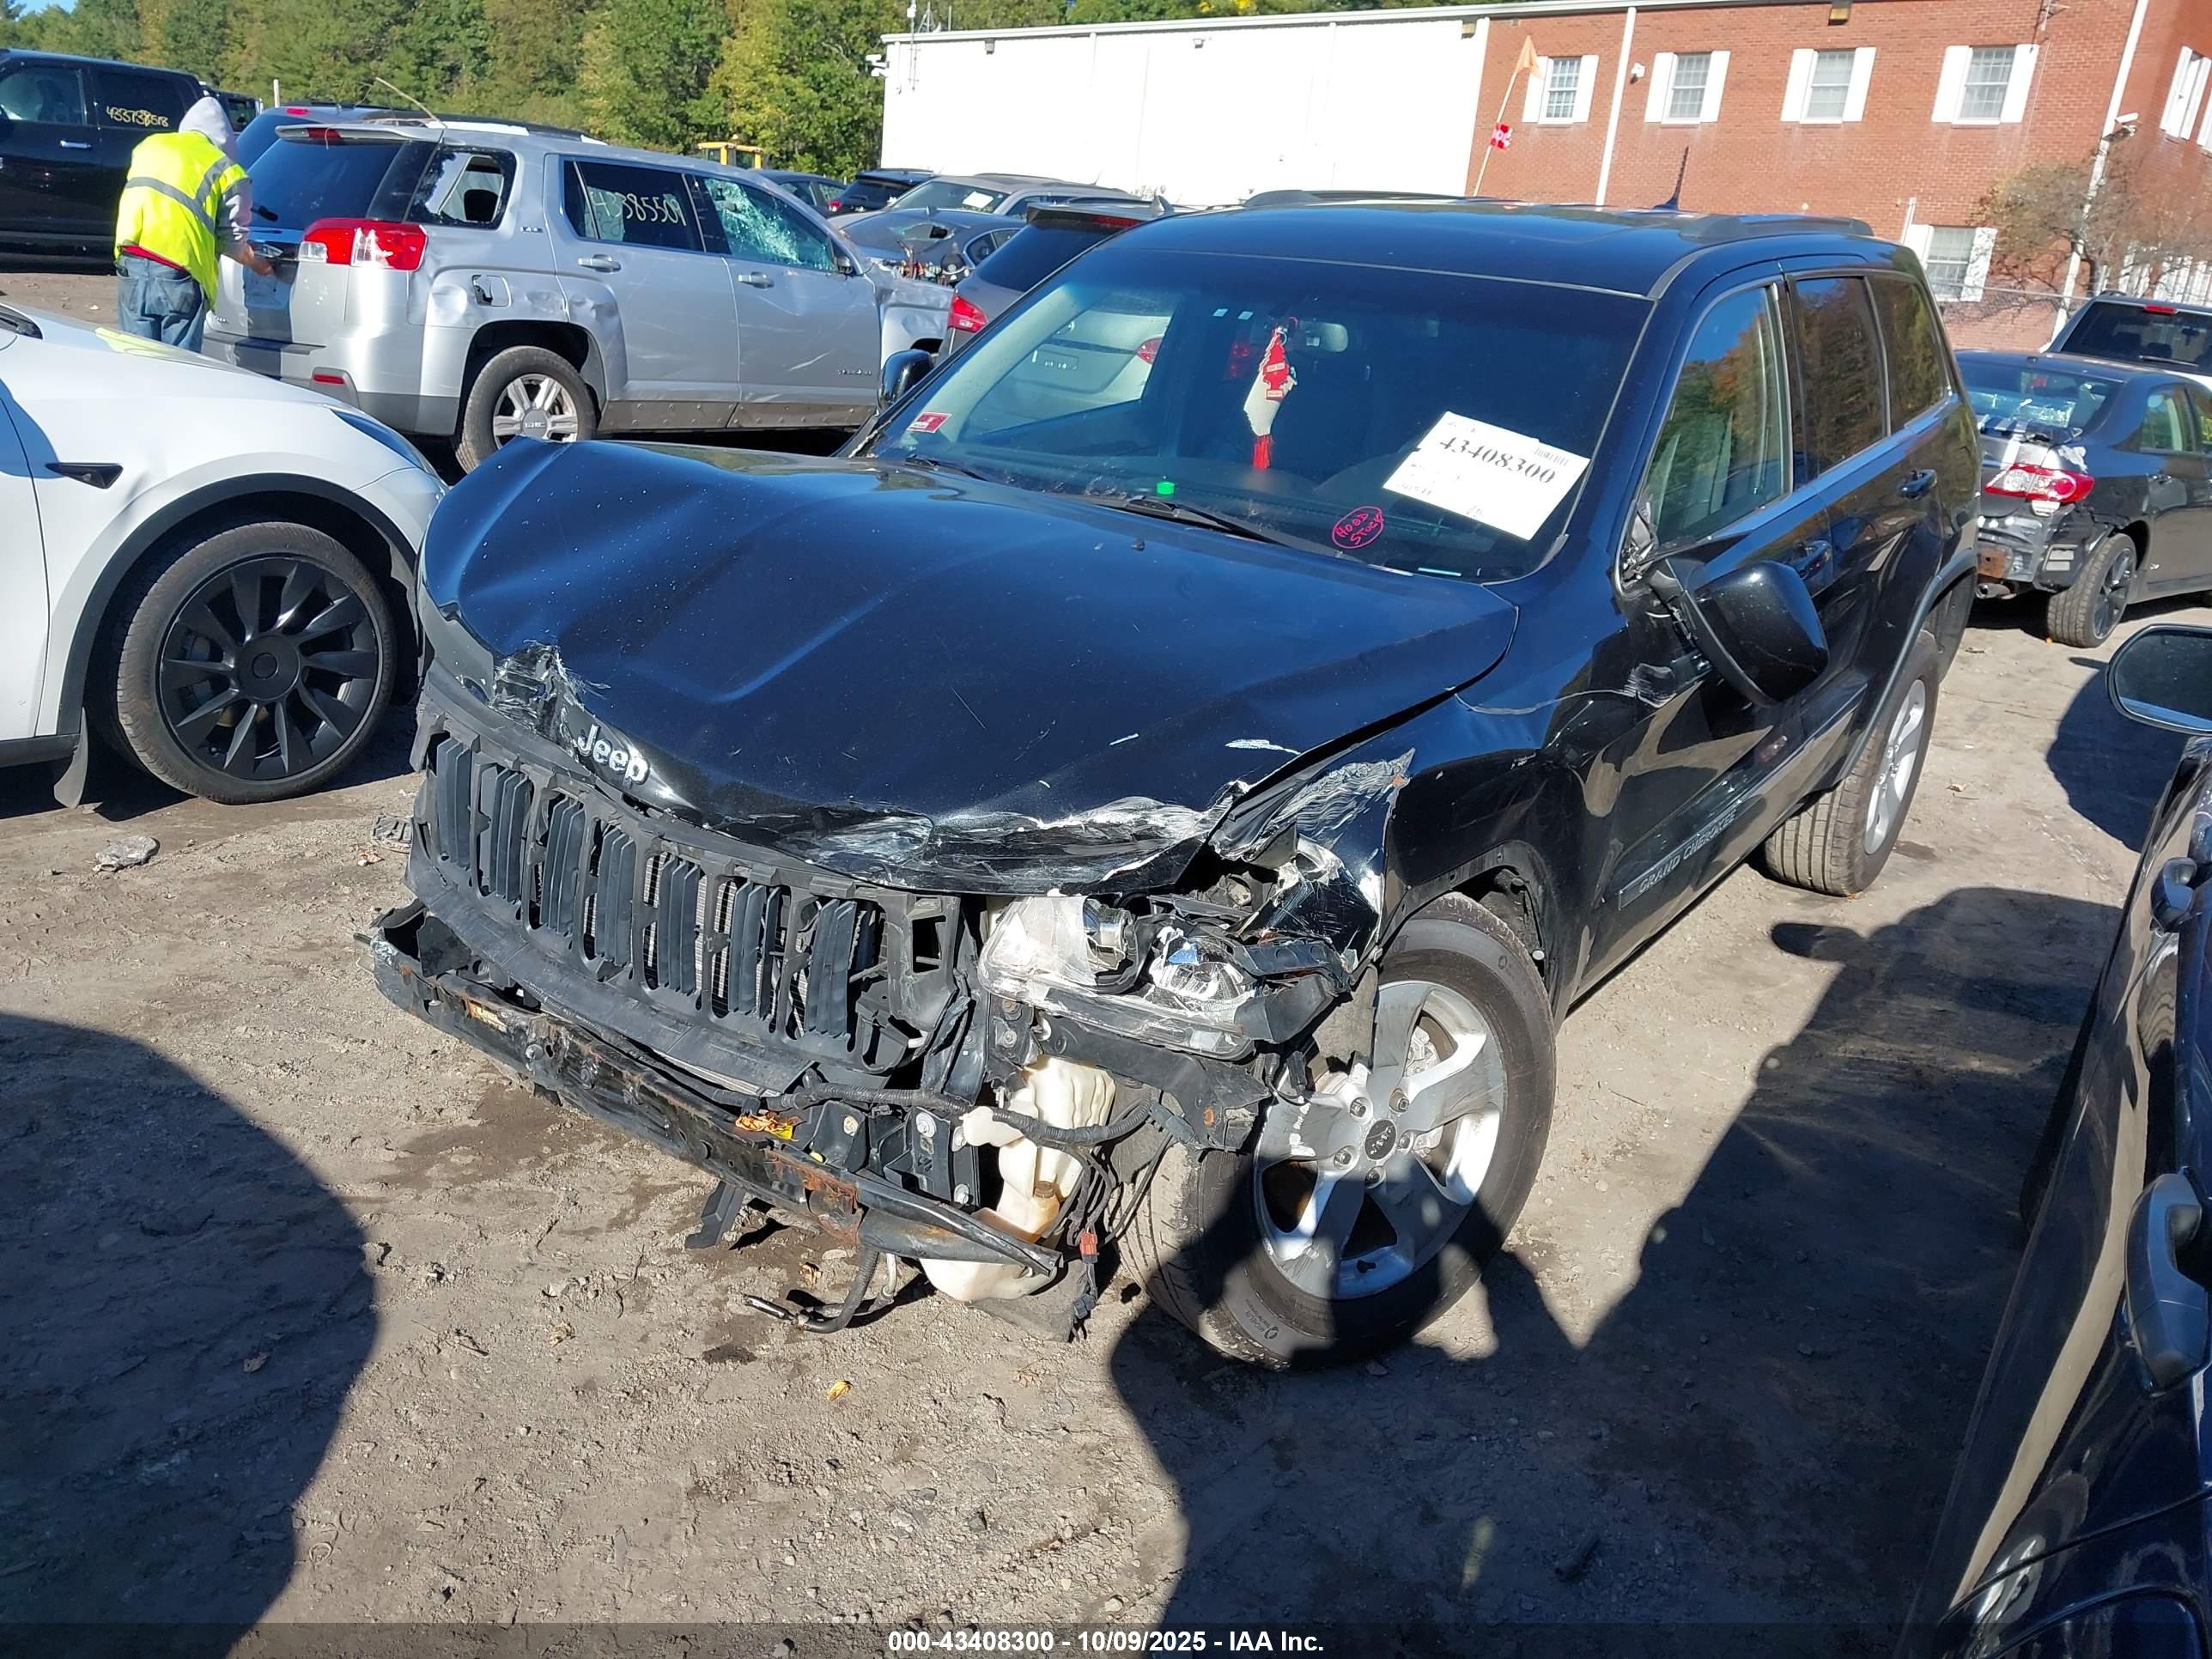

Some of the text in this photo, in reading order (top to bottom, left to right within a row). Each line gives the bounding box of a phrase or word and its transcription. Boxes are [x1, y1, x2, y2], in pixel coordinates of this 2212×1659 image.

[589, 191, 687, 226] 43385509
[1438, 436, 1556, 484] 43408300
[577, 723, 650, 790] Jeep
[1639, 854, 1680, 893] GRAND
